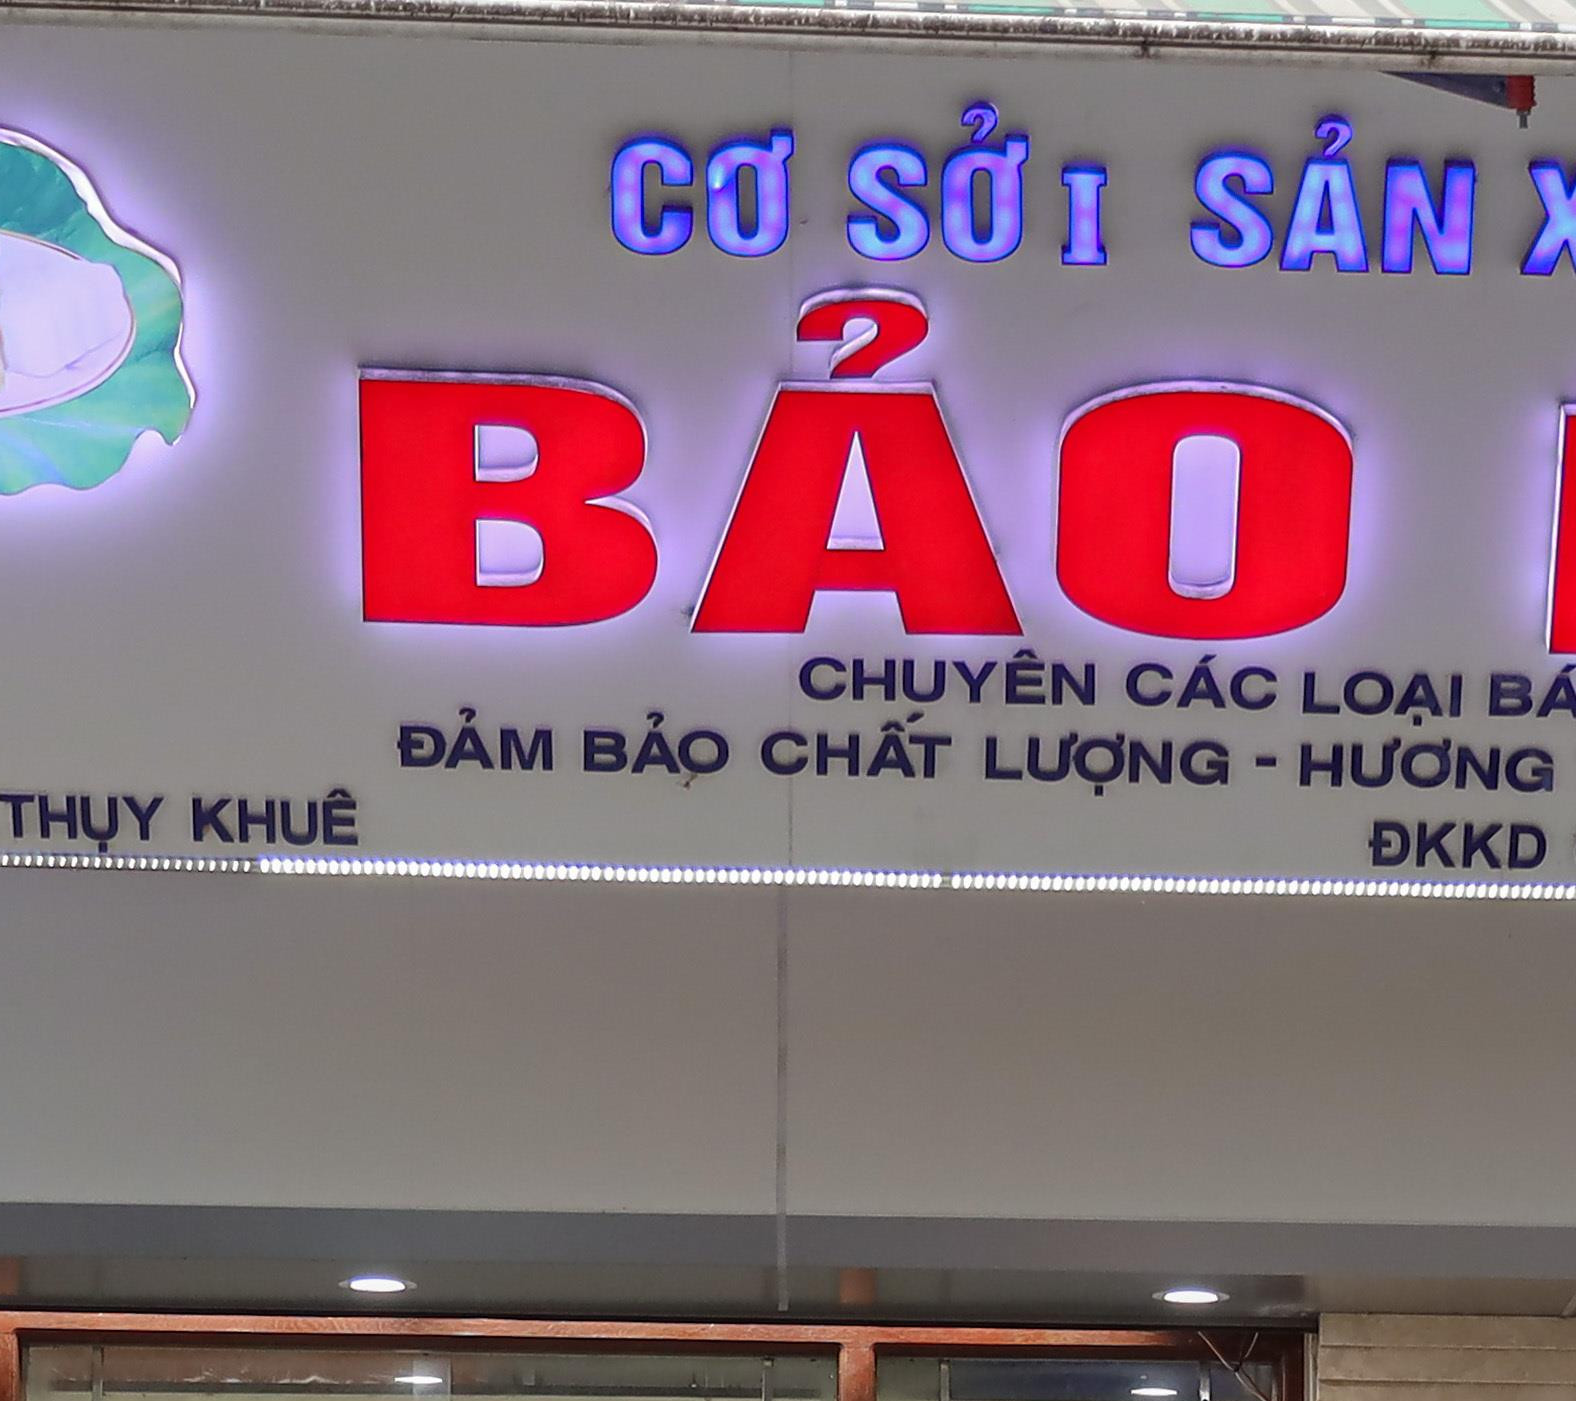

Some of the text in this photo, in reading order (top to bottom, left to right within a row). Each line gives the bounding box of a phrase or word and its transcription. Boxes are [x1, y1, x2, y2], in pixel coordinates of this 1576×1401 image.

[611, 129, 795, 257] CƠ
[846, 101, 1030, 264] SỞ
[1189, 117, 1474, 276] SẢN
[358, 287, 1355, 640] BẢO
[797, 648, 1097, 707] CHUYÊN
[1124, 654, 1279, 712] CÁC
[1301, 669, 1464, 728] LOẠI
[395, 705, 555, 773] ĐẢM
[582, 710, 731, 776] BẢO
[759, 709, 954, 780] CHẤT
[983, 730, 1231, 798] LƯỢNG
[1298, 735, 1556, 794] HƯƠNG
[190, 786, 360, 848] KHUÊ
[1366, 818, 1548, 872] ĐKKD
